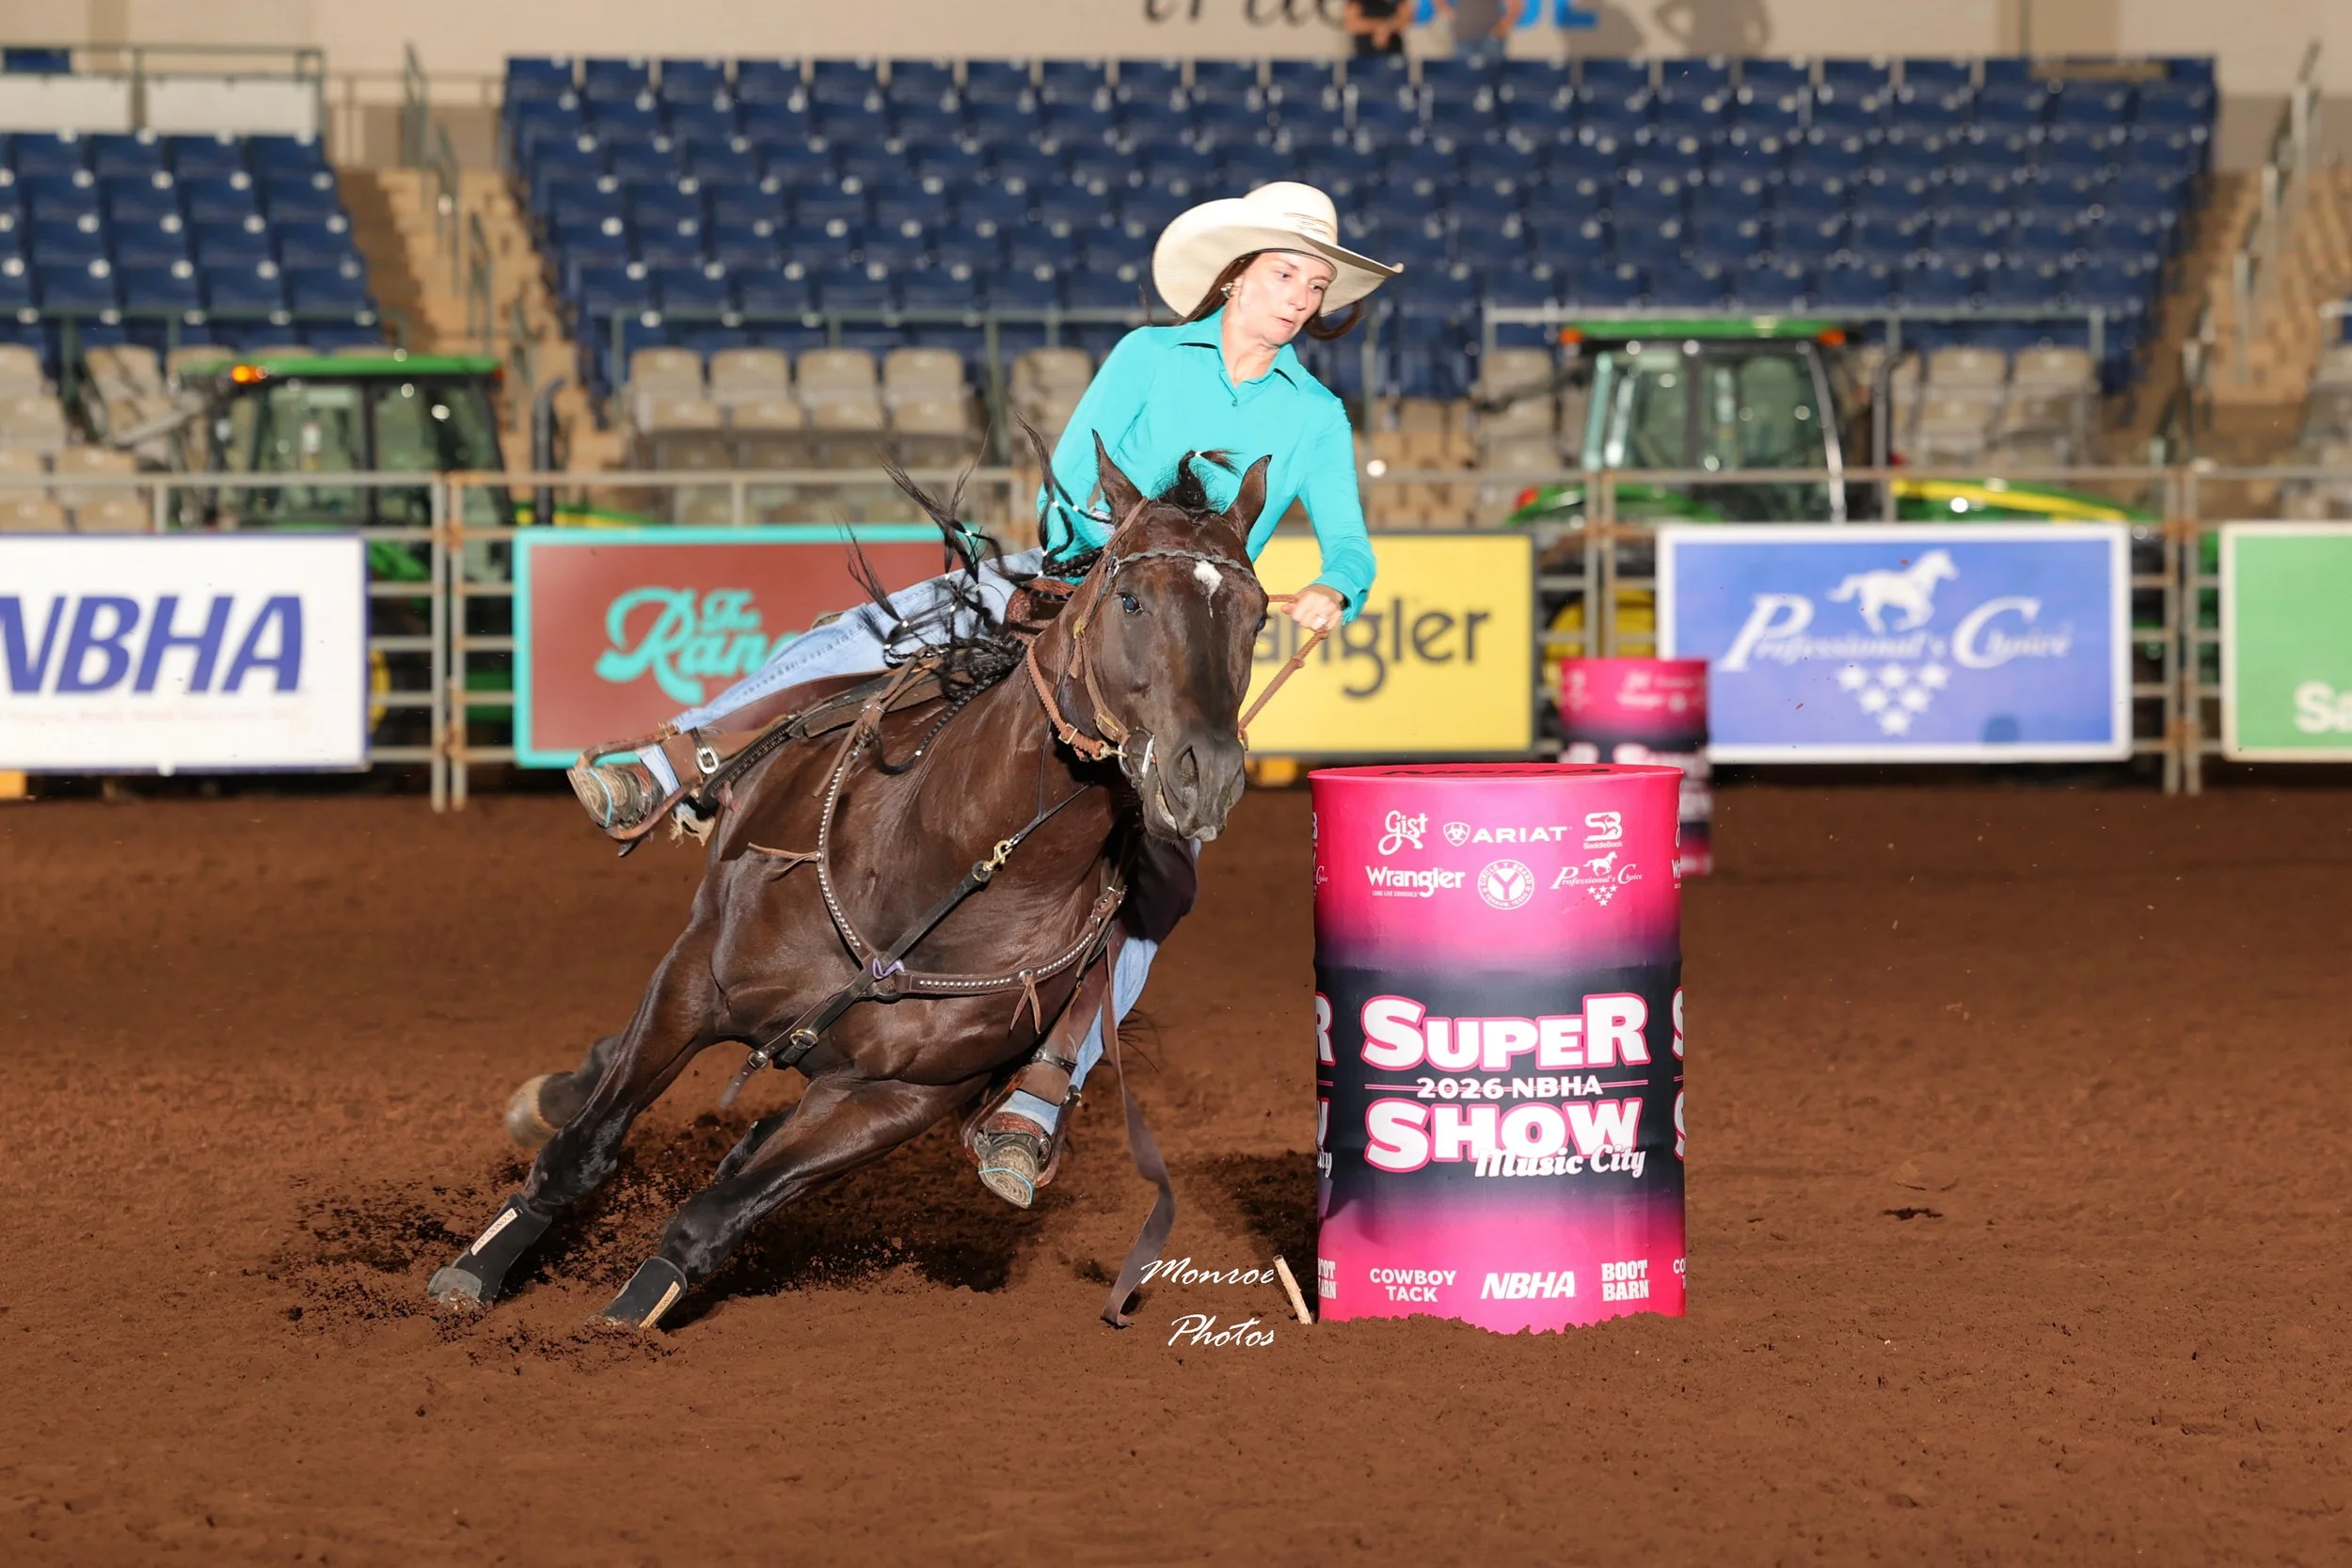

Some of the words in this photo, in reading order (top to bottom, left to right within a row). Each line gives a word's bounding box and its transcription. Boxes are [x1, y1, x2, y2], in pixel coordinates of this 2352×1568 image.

[702, 587, 762, 634] The
[0, 594, 304, 695] NBHA
[1951, 595, 2074, 670] Choice
[1251, 597, 1491, 698] angler
[1377, 810, 1429, 856] Gist
[1471, 826, 1568, 844] ARIAT
[1582, 841, 1623, 849] SaddleBook
[1365, 865, 1466, 898] Wrangler
[1480, 863, 1499, 886] CIRCLE
[1513, 863, 1533, 885] BRAND
[1549, 866, 1615, 890] Professional's
[1617, 863, 1643, 884] Choice
[1361, 993, 1650, 1072] SUPER
[1417, 1077, 1505, 1099] 2026
[1512, 1075, 1603, 1099] NBHA
[1364, 1098, 1643, 1172] SHOW
[1474, 1148, 1584, 1178] Music
[1589, 1144, 1646, 1179] City
[1369, 1268, 1457, 1287] COWBOY
[1601, 1259, 1648, 1278] BOOT
[1386, 1286, 1438, 1303] TACK
[1481, 1271, 1577, 1300] NBHA
[1602, 1279, 1650, 1302] BARN
